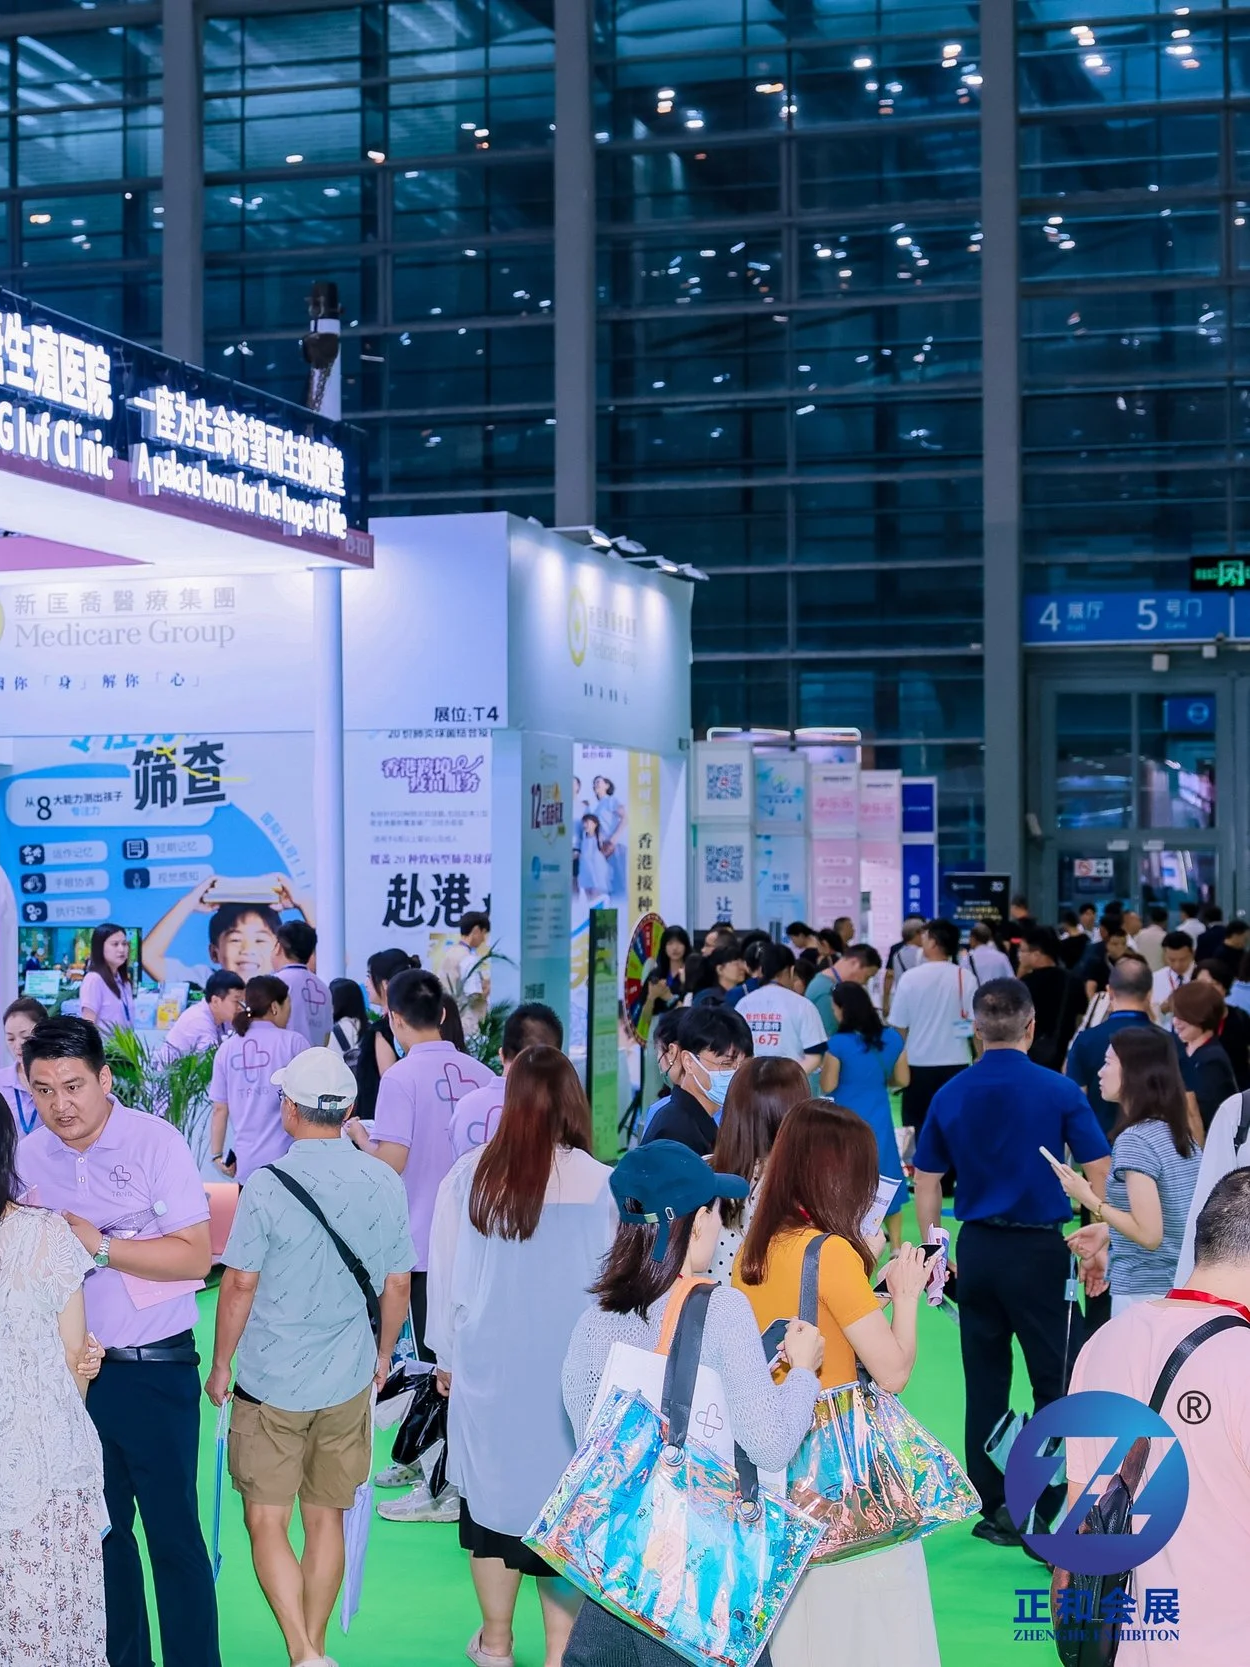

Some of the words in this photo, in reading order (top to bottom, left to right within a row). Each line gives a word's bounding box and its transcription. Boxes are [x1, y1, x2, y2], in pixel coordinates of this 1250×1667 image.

[53, 418, 115, 481] Clinic
[133, 384, 347, 497] 一座为生命希望而生的殿堂
[137, 442, 152, 483] A
[152, 449, 202, 496] palace
[258, 479, 282, 521] the
[282, 485, 314, 537] hope
[314, 497, 329, 534] of
[14, 586, 237, 616] 新匡喬醫療集團
[1038, 601, 1062, 633] 4
[1067, 601, 1104, 620] 展厅
[1136, 598, 1158, 631] 5
[1166, 598, 1203, 618] 号门
[14, 623, 142, 648] Medicare
[148, 619, 237, 649] Group
[132, 740, 227, 812] 筛查
[382, 872, 492, 929] 赴港
